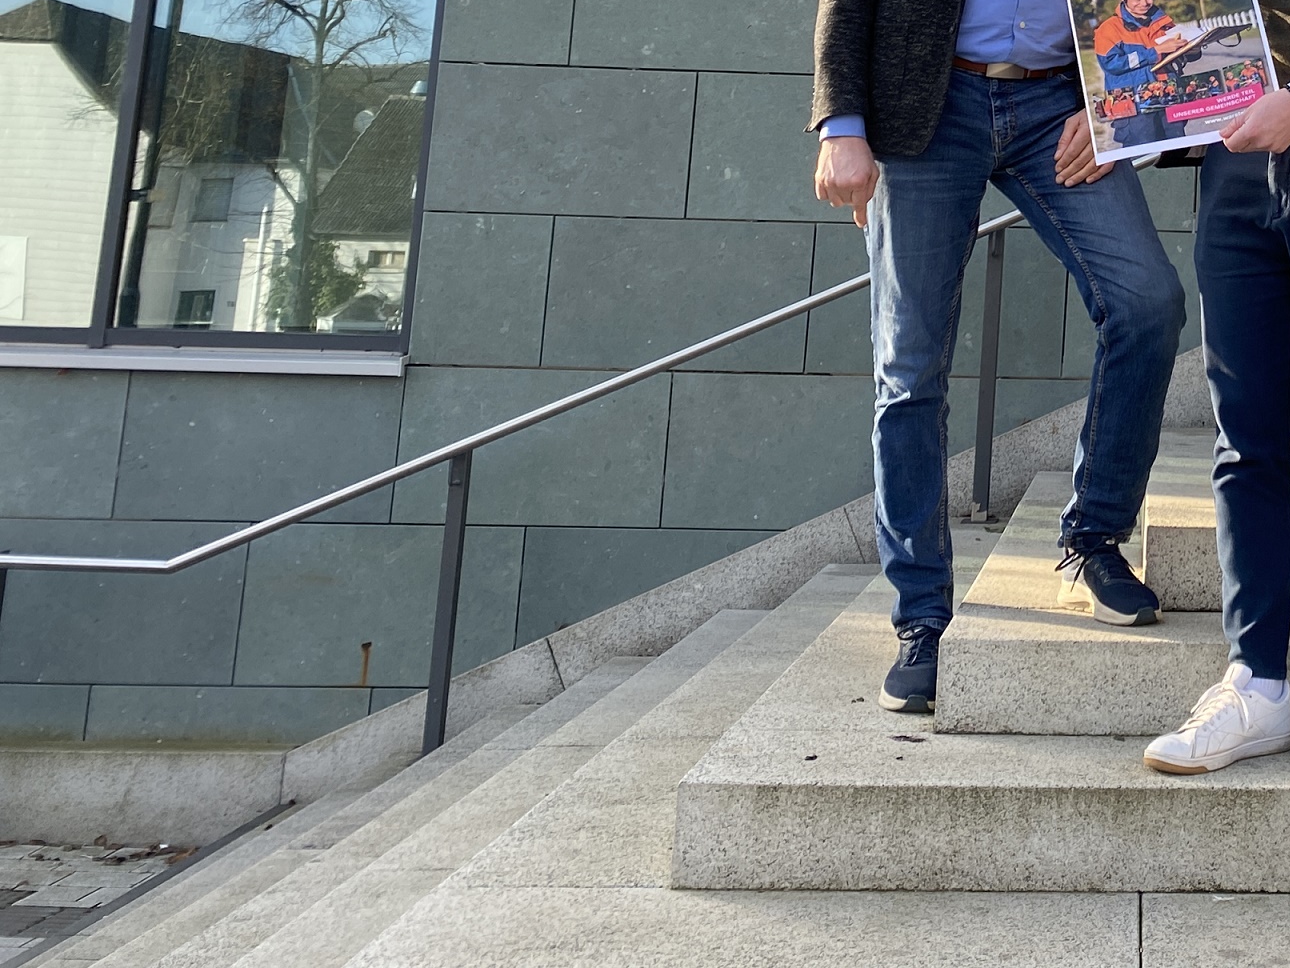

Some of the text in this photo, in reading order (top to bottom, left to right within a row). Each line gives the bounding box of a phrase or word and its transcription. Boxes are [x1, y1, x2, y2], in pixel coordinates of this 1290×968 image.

[1172, 93, 1256, 118] UNSERER GEMEINSCHAFT
[1216, 88, 1255, 103] WERDE TEIL
